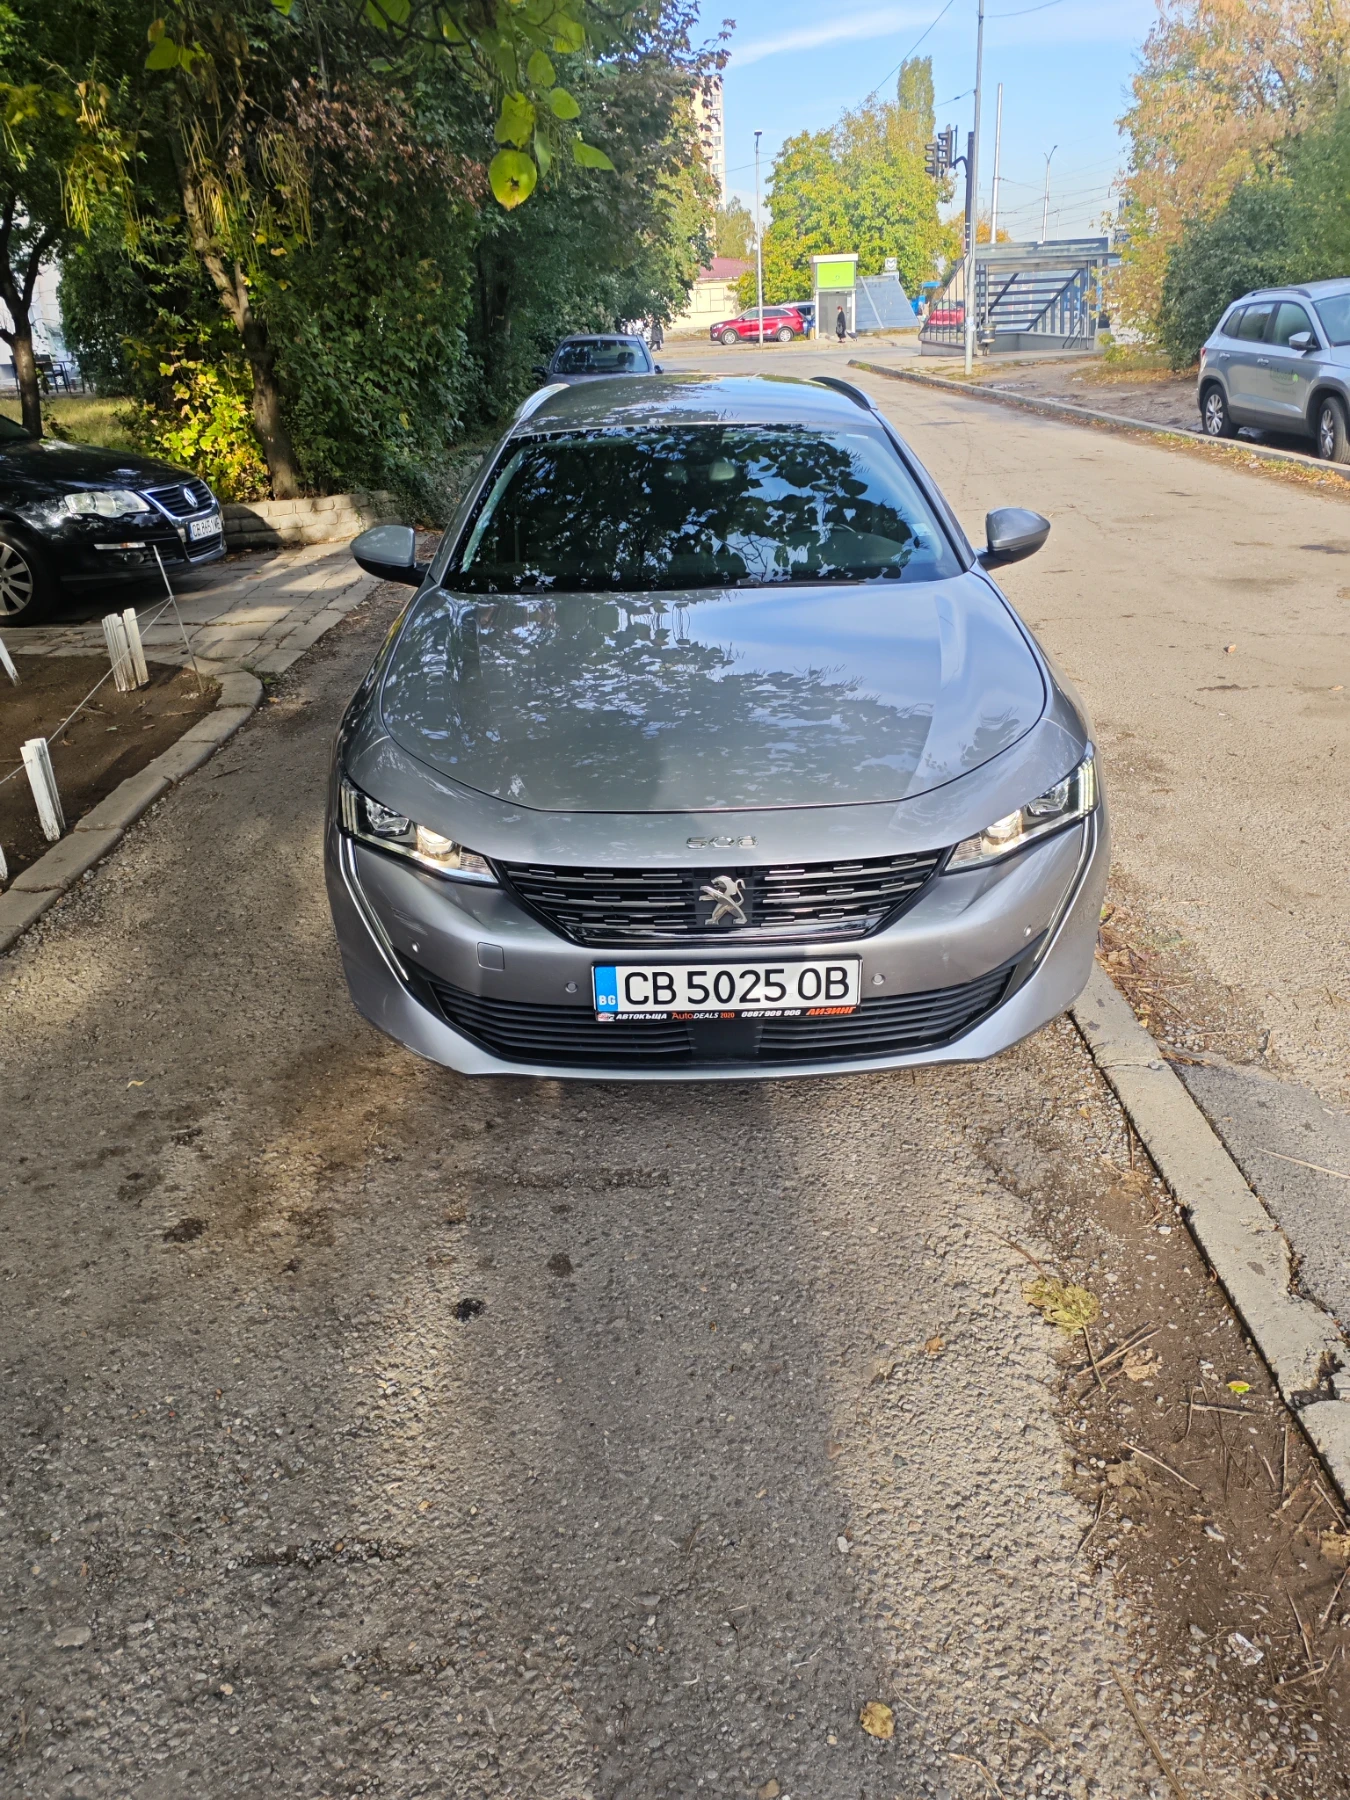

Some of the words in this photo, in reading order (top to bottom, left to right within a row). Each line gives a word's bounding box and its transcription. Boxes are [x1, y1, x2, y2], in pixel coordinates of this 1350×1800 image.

[625, 971, 677, 1005] CB
[687, 969, 787, 1004] 5025
[599, 995, 616, 1005] BG
[806, 1006, 856, 1016] ЛИЗИНГ
